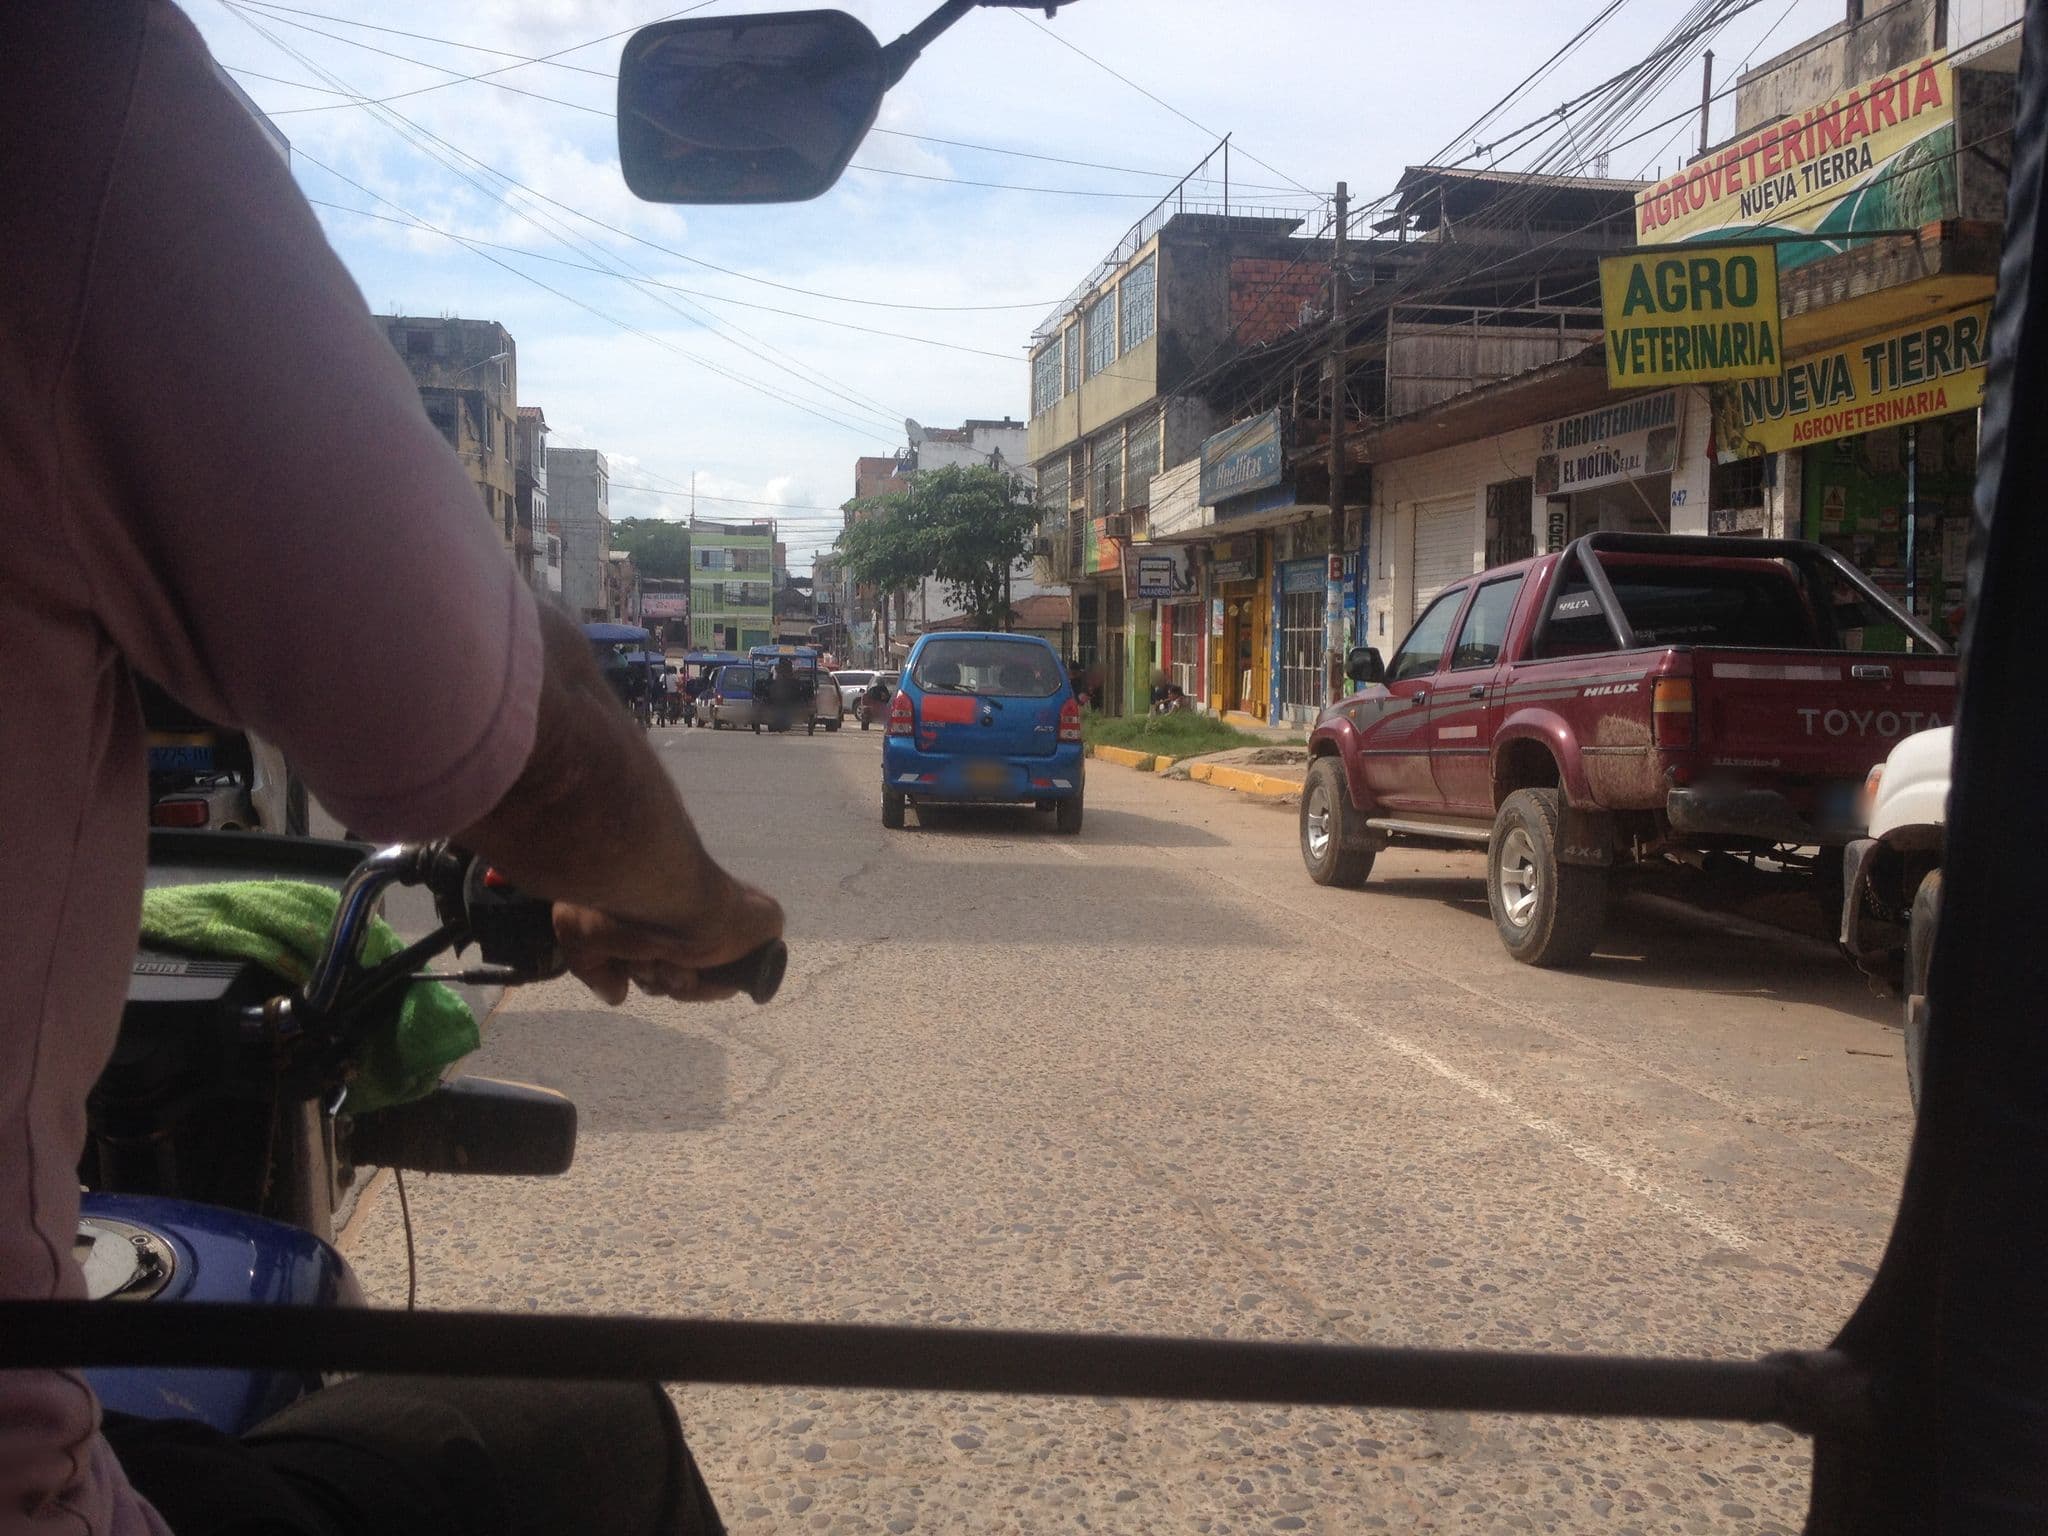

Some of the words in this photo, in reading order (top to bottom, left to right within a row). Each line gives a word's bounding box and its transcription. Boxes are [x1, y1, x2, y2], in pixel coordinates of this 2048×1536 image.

[1640, 58, 1943, 235] AGROVETERINARIA
[1740, 174, 1797, 220] NUEVA
[1802, 141, 1873, 200] TIERRA
[1622, 255, 1758, 317] AGRO
[1611, 321, 1776, 377] VETERINARIA
[1740, 352, 1856, 427] NUEVA
[1793, 387, 1948, 443] AGROVETERINARIA
[1557, 392, 1676, 449] AGROVETERINARIA
[1564, 460, 1576, 483] EL
[1578, 448, 1621, 482] MOLINO
[1672, 490, 1687, 507] 247
[1559, 600, 1590, 611] HILUX
[1583, 683, 1640, 698] HILUX
